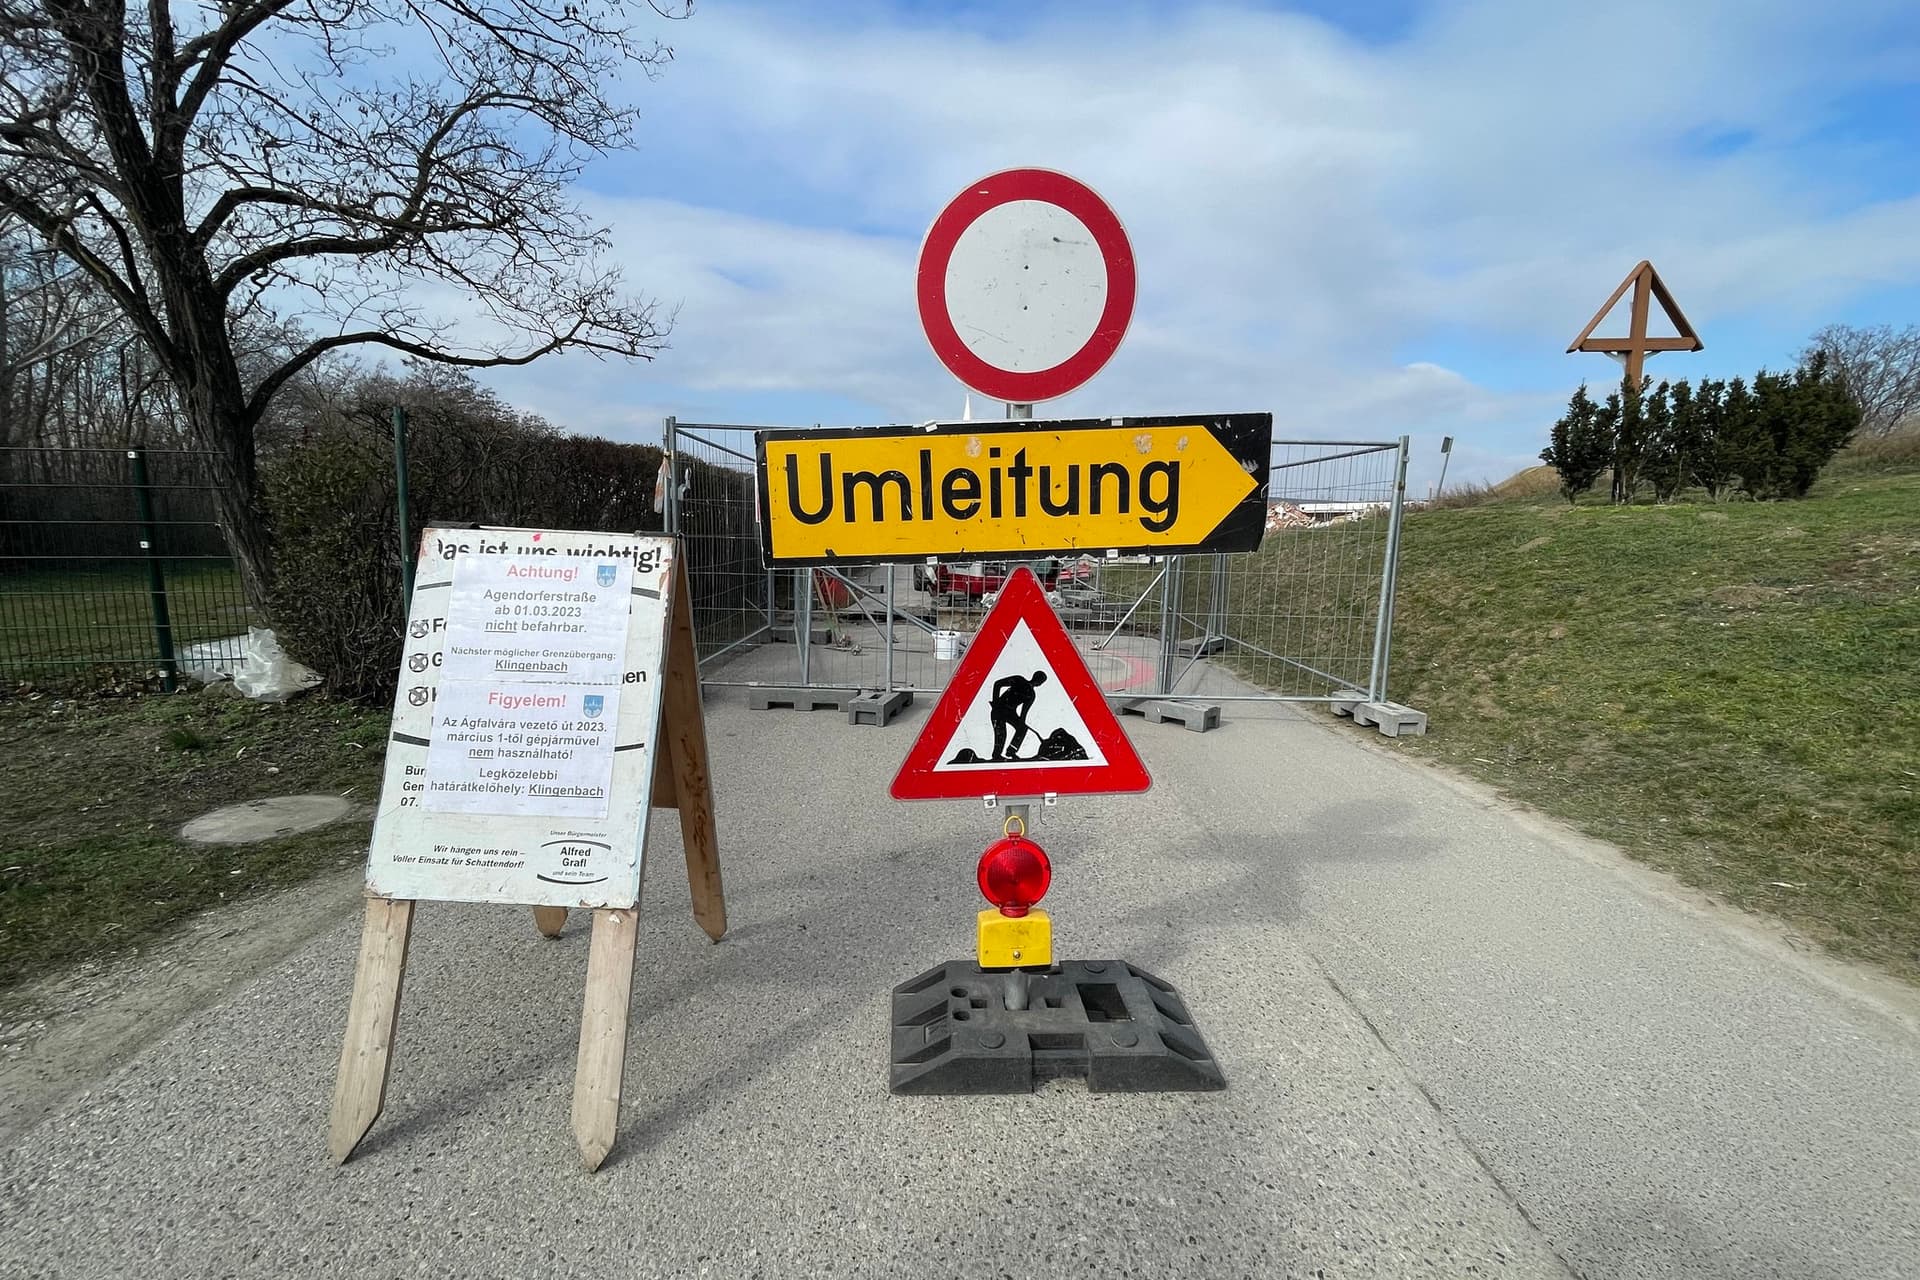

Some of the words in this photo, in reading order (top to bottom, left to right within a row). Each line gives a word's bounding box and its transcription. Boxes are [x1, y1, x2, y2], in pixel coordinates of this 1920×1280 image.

[785, 445, 1180, 534] Umleitung
[506, 564, 579, 582] Achtung!
[483, 589, 597, 603] Agendorferstraße
[494, 604, 510, 615] ab
[514, 604, 582, 618] 01.03.2023
[484, 619, 517, 632] nicht
[521, 620, 587, 633] befahrbar.
[450, 646, 492, 656] Nächster
[494, 648, 539, 659] möglicher
[542, 649, 616, 662] Grenzübergang:
[495, 659, 568, 673] Klingenbach
[488, 692, 567, 710] Figyelem!
[442, 716, 457, 727] Az
[460, 714, 516, 730] Ágfalvára
[519, 719, 558, 730] vezető
[561, 720, 573, 731] út
[576, 721, 607, 732] 2023.
[447, 731, 493, 742] március
[498, 732, 523, 744] 1-től
[526, 733, 600, 747] gépjárművel
[468, 748, 494, 758] nem
[497, 747, 573, 760] használható!
[479, 767, 558, 781] Legközelebbi
[430, 780, 525, 796] határátkelőhely:
[528, 783, 604, 798] Klingenbach
[400, 796, 419, 807] 07.
[433, 844, 449, 853] Wir
[483, 848, 499, 856] uns
[501, 848, 518, 857] rein
[560, 846, 591, 857] Alfred
[392, 854, 416, 863] Voller
[418, 855, 449, 865] Einsatz
[465, 858, 525, 869] Schattendorf!
[562, 857, 587, 867] Grafl
